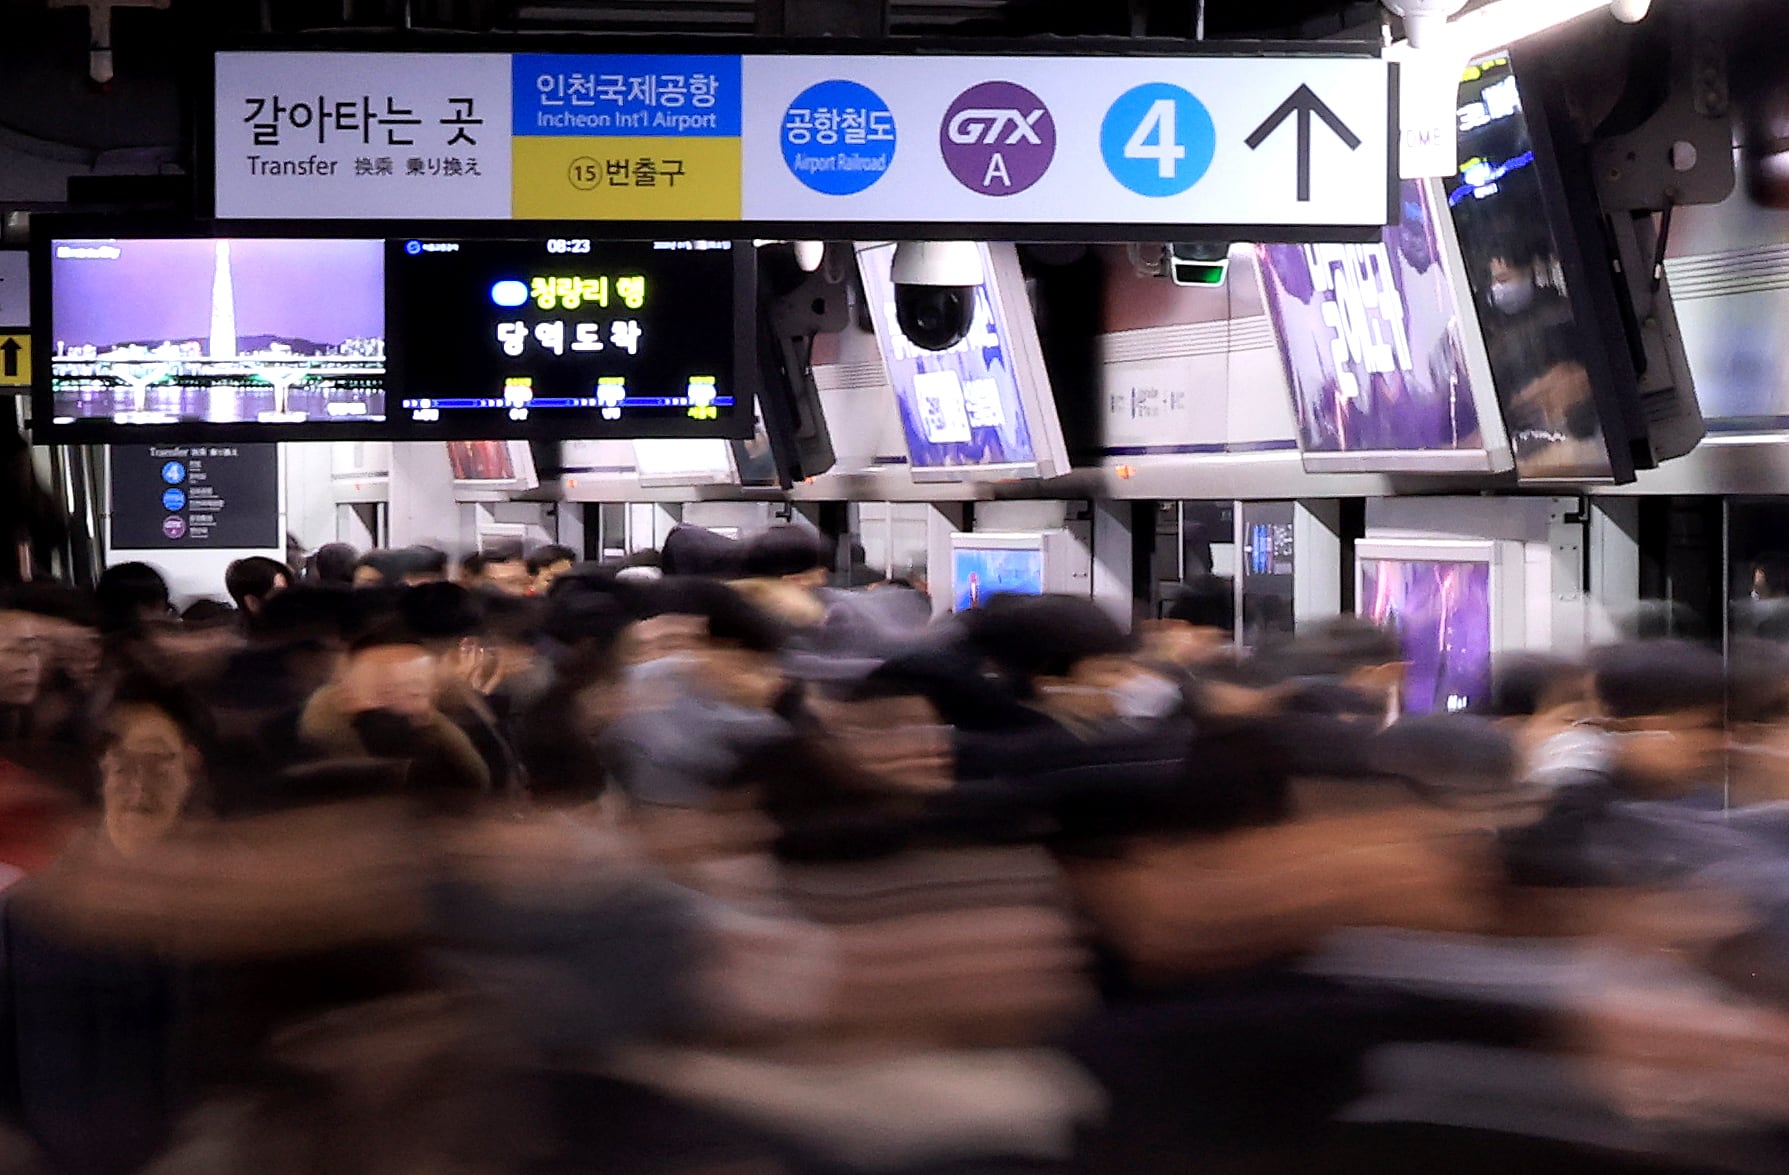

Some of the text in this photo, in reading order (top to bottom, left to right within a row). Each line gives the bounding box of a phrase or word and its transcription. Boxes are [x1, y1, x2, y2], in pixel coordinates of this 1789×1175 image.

[537, 74, 718, 108] 인천국제공항
[244, 95, 483, 146] 갈아타는 곳
[538, 111, 611, 128] Incheon
[652, 111, 716, 131] Airport
[786, 107, 895, 145] 공항철도
[948, 108, 1045, 145] GTX
[1123, 98, 1186, 179] 4
[247, 154, 338, 176] Transfer
[794, 153, 886, 174] Airport Railroad
[983, 152, 1011, 187] A
[547, 239, 590, 253] 08:23
[531, 275, 608, 310] 청량리
[616, 275, 646, 310] 행
[166, 464, 180, 481] 4
